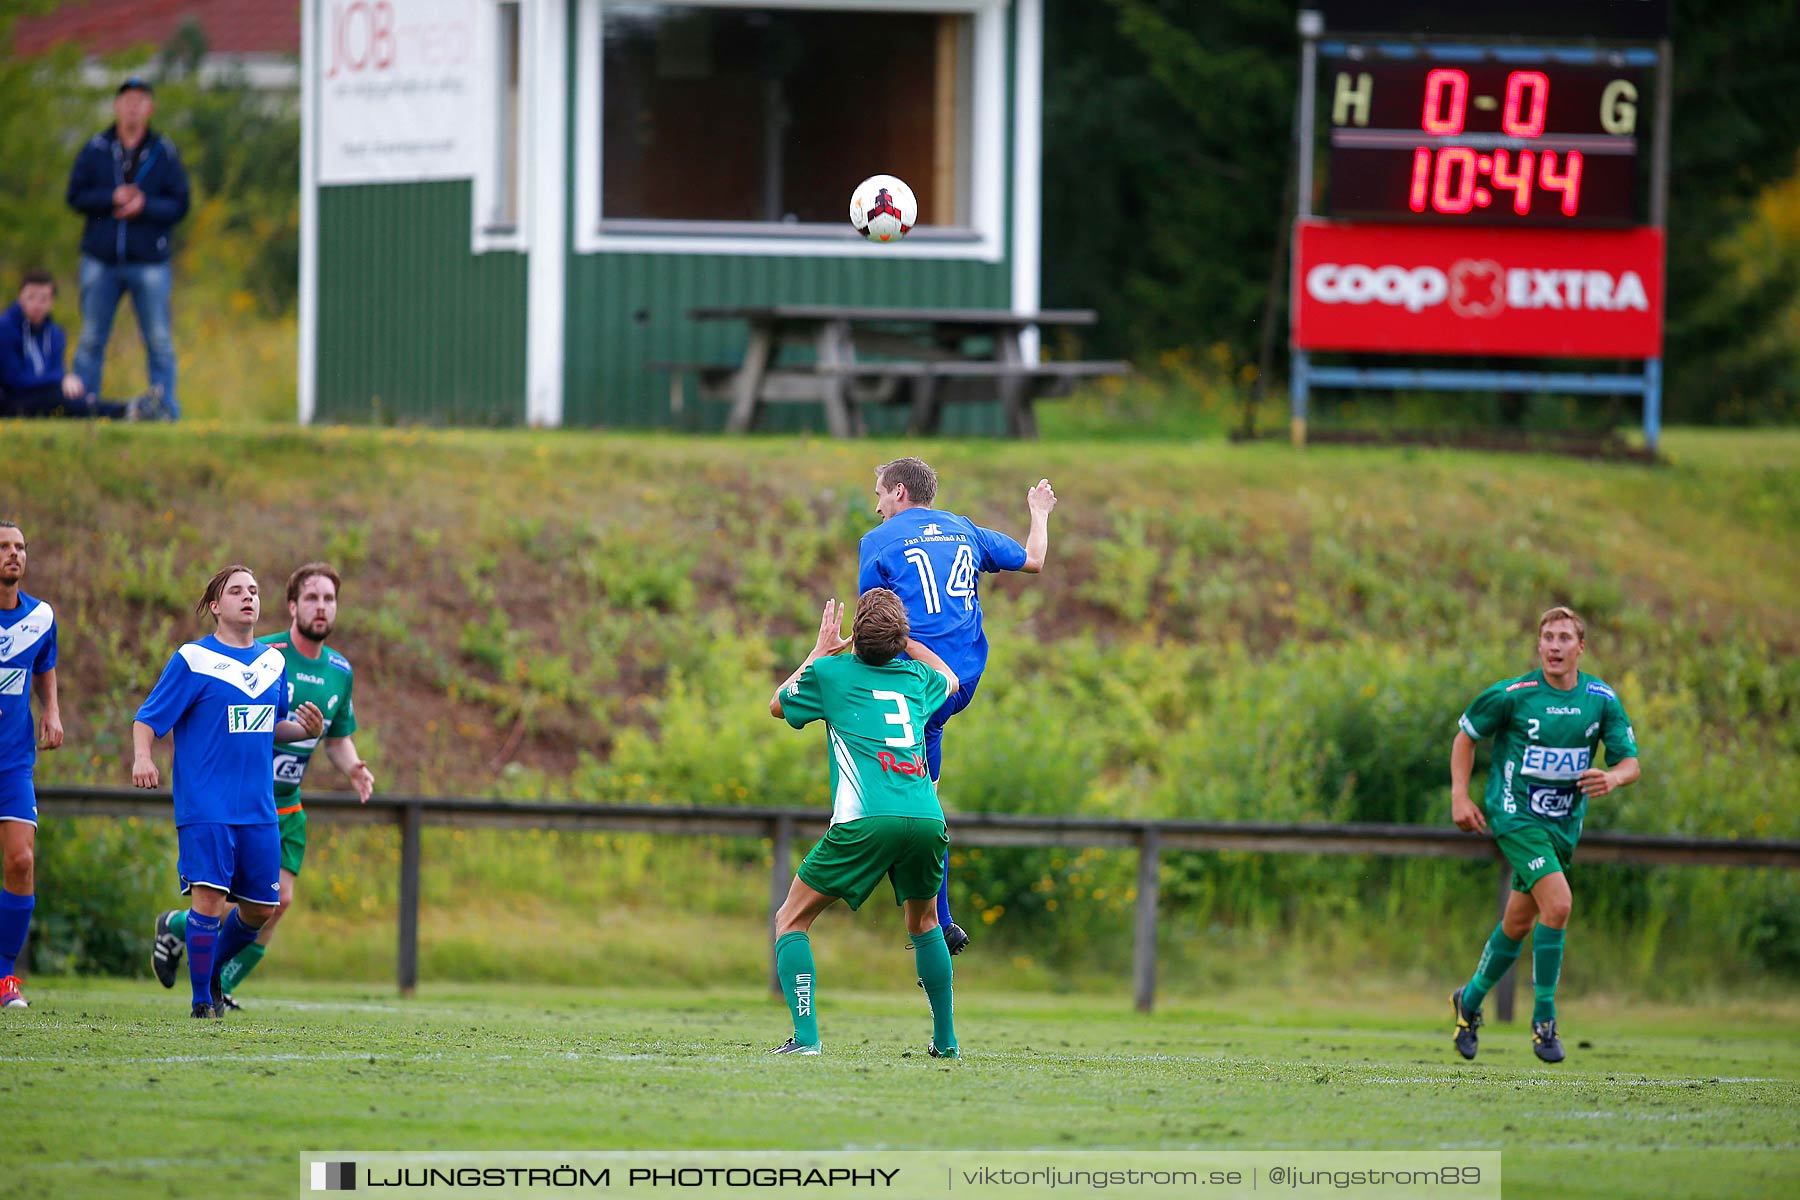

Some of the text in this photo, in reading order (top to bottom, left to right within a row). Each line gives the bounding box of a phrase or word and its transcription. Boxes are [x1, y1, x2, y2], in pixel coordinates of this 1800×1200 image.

[1332, 72, 1373, 127] H
[1600, 79, 1638, 135] G
[1409, 146, 1583, 216] 10:44
[1306, 263, 1649, 312] coop EXTRA
[903, 538, 919, 546] Jan
[955, 534, 967, 542] AB
[903, 544, 975, 615] 14
[296, 672, 325, 686] stadium
[872, 690, 916, 748] 3
[1545, 705, 1582, 715] stadium
[1527, 718, 1540, 740] 2
[1525, 749, 1589, 772] EPAB
[1530, 788, 1574, 817] CEJN
[794, 973, 812, 1017] stadium
